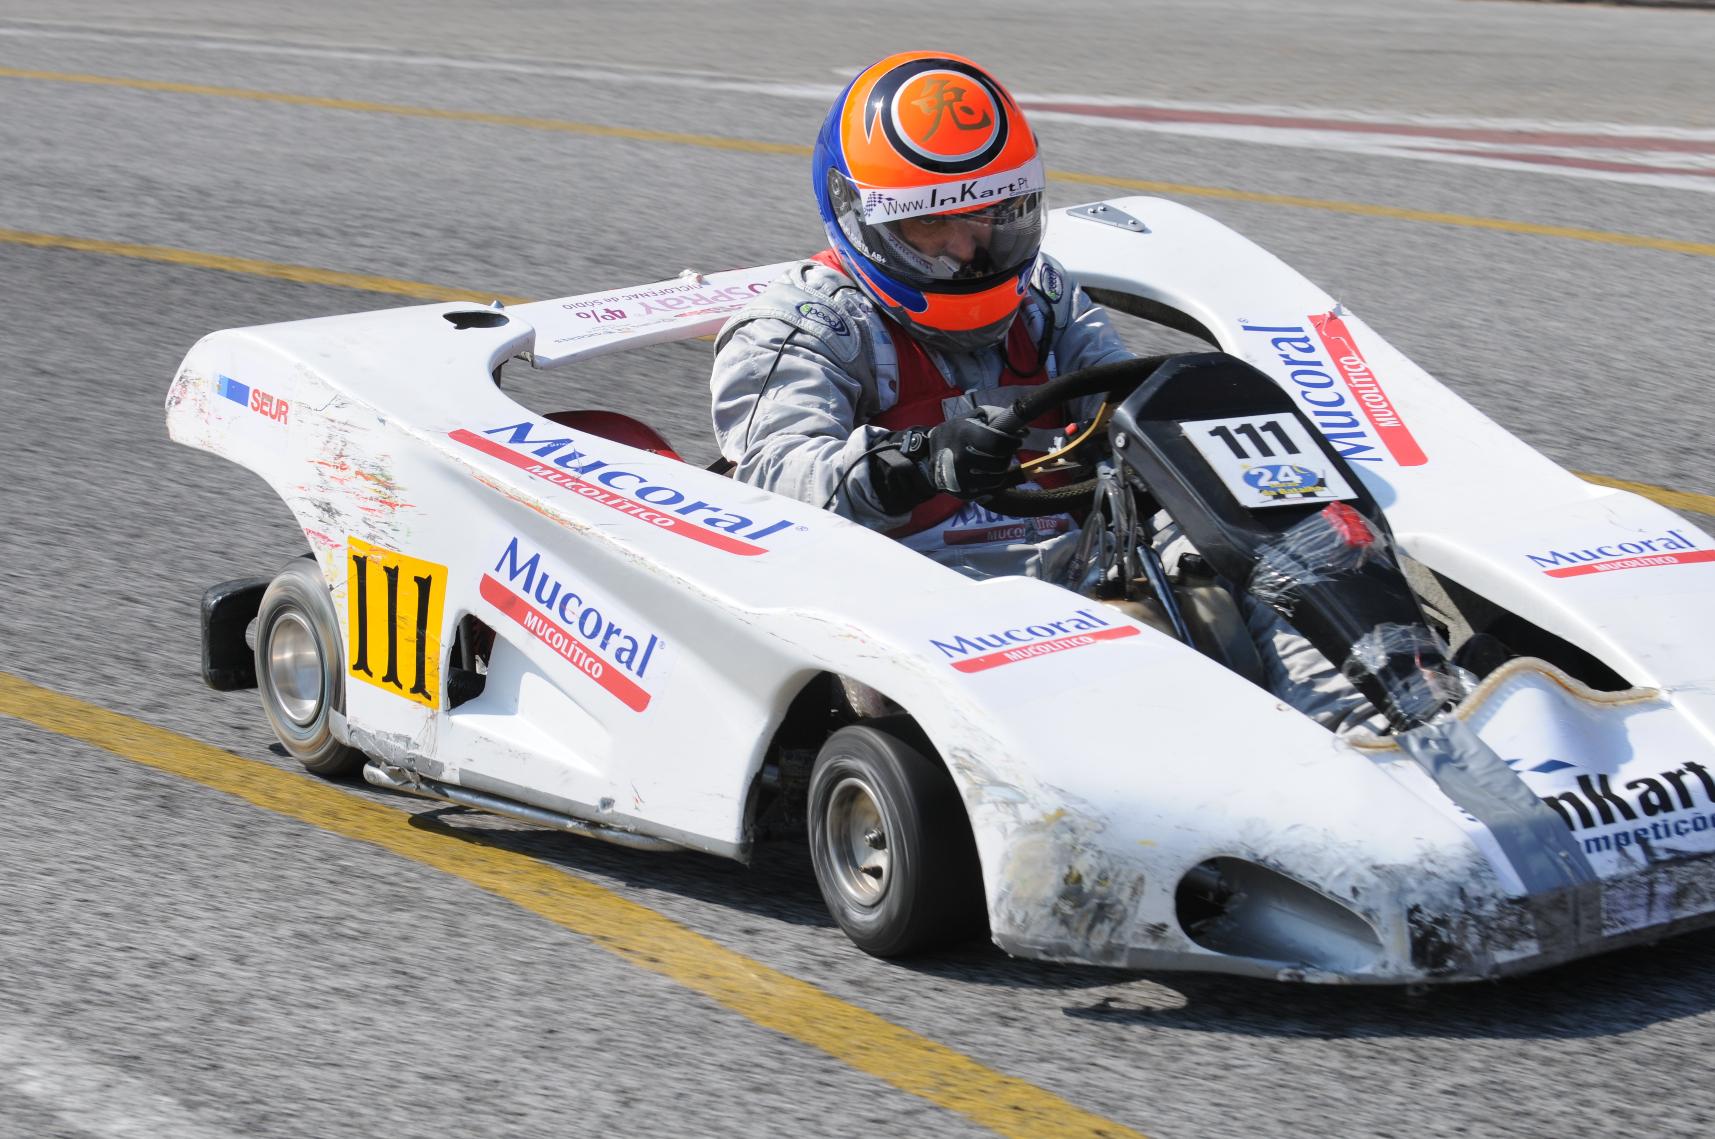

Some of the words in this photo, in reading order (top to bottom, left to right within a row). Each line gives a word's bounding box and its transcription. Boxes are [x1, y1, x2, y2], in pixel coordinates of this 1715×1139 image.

[576, 307, 627, 323] 4%
[250, 388, 289, 425] SEUR
[1242, 324, 1384, 462] Mucoral
[1339, 355, 1401, 427] MUCOLÍTICO
[1208, 420, 1302, 459] 111
[483, 421, 794, 540] Mucoral
[523, 464, 676, 528] MUCOLÍTICO
[1525, 530, 1696, 568] Mucoral
[352, 554, 432, 702] 111
[494, 536, 658, 678] Mucoral
[929, 609, 1109, 659] Mucoral
[523, 610, 603, 680] MUCOLÍTICO
[1541, 761, 1715, 832] nKart
